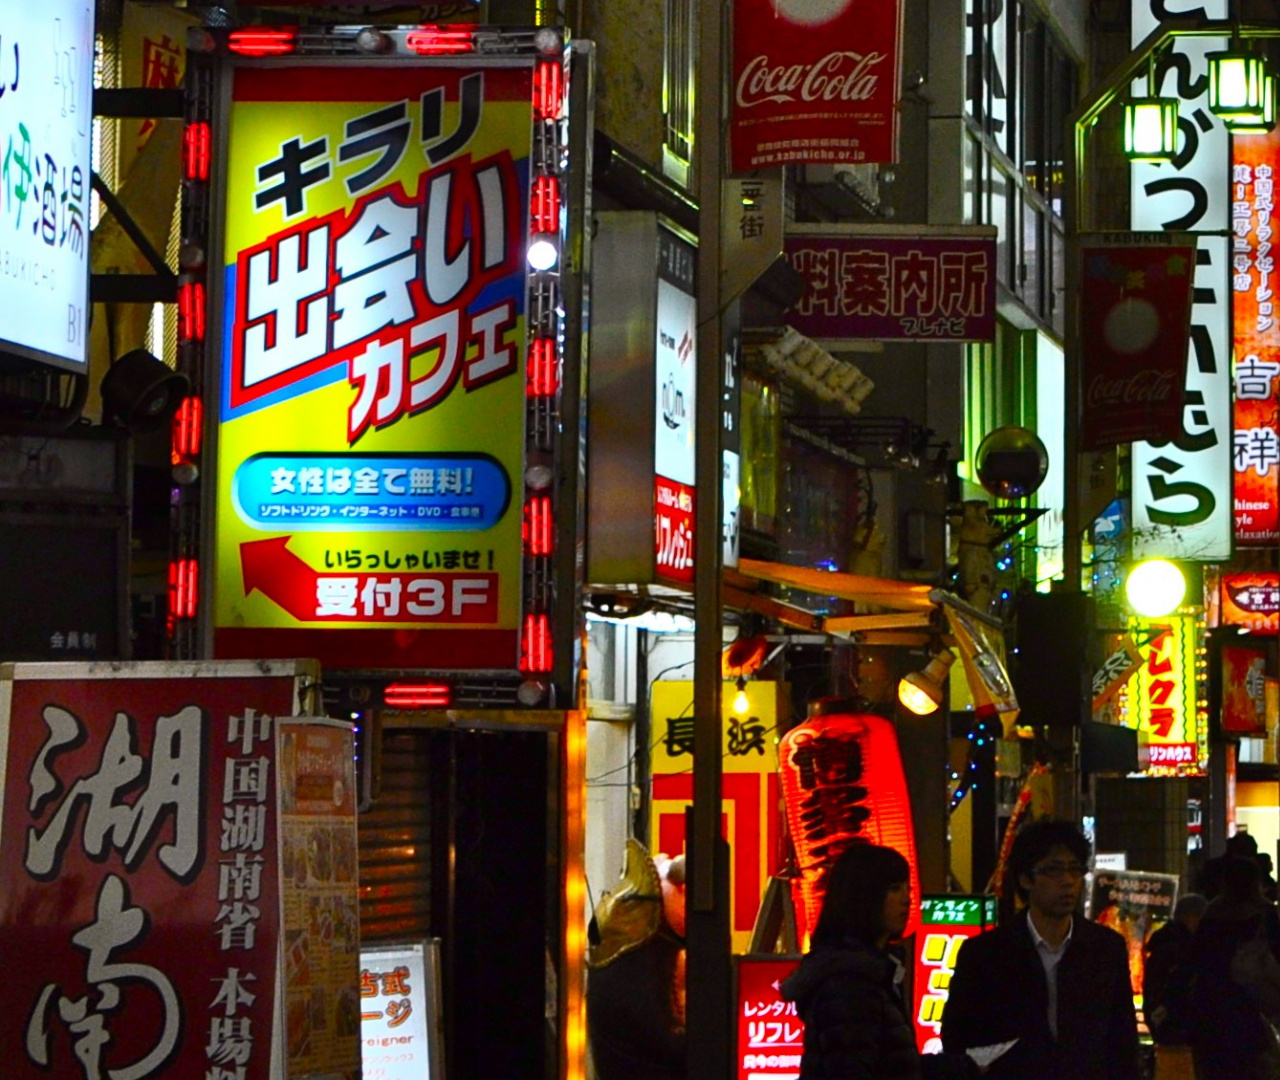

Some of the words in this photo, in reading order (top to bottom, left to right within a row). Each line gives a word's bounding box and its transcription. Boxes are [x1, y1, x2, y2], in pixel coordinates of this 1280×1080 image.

[735, 51, 890, 108] Coca-Cola
[253, 73, 484, 219] キラリ
[242, 166, 506, 389] 出会い
[349, 302, 517, 434] カフェ
[49, 632, 97, 650] 会員制
[314, 576, 491, 617] 受付3F
[215, 709, 272, 952] 中国湖南省
